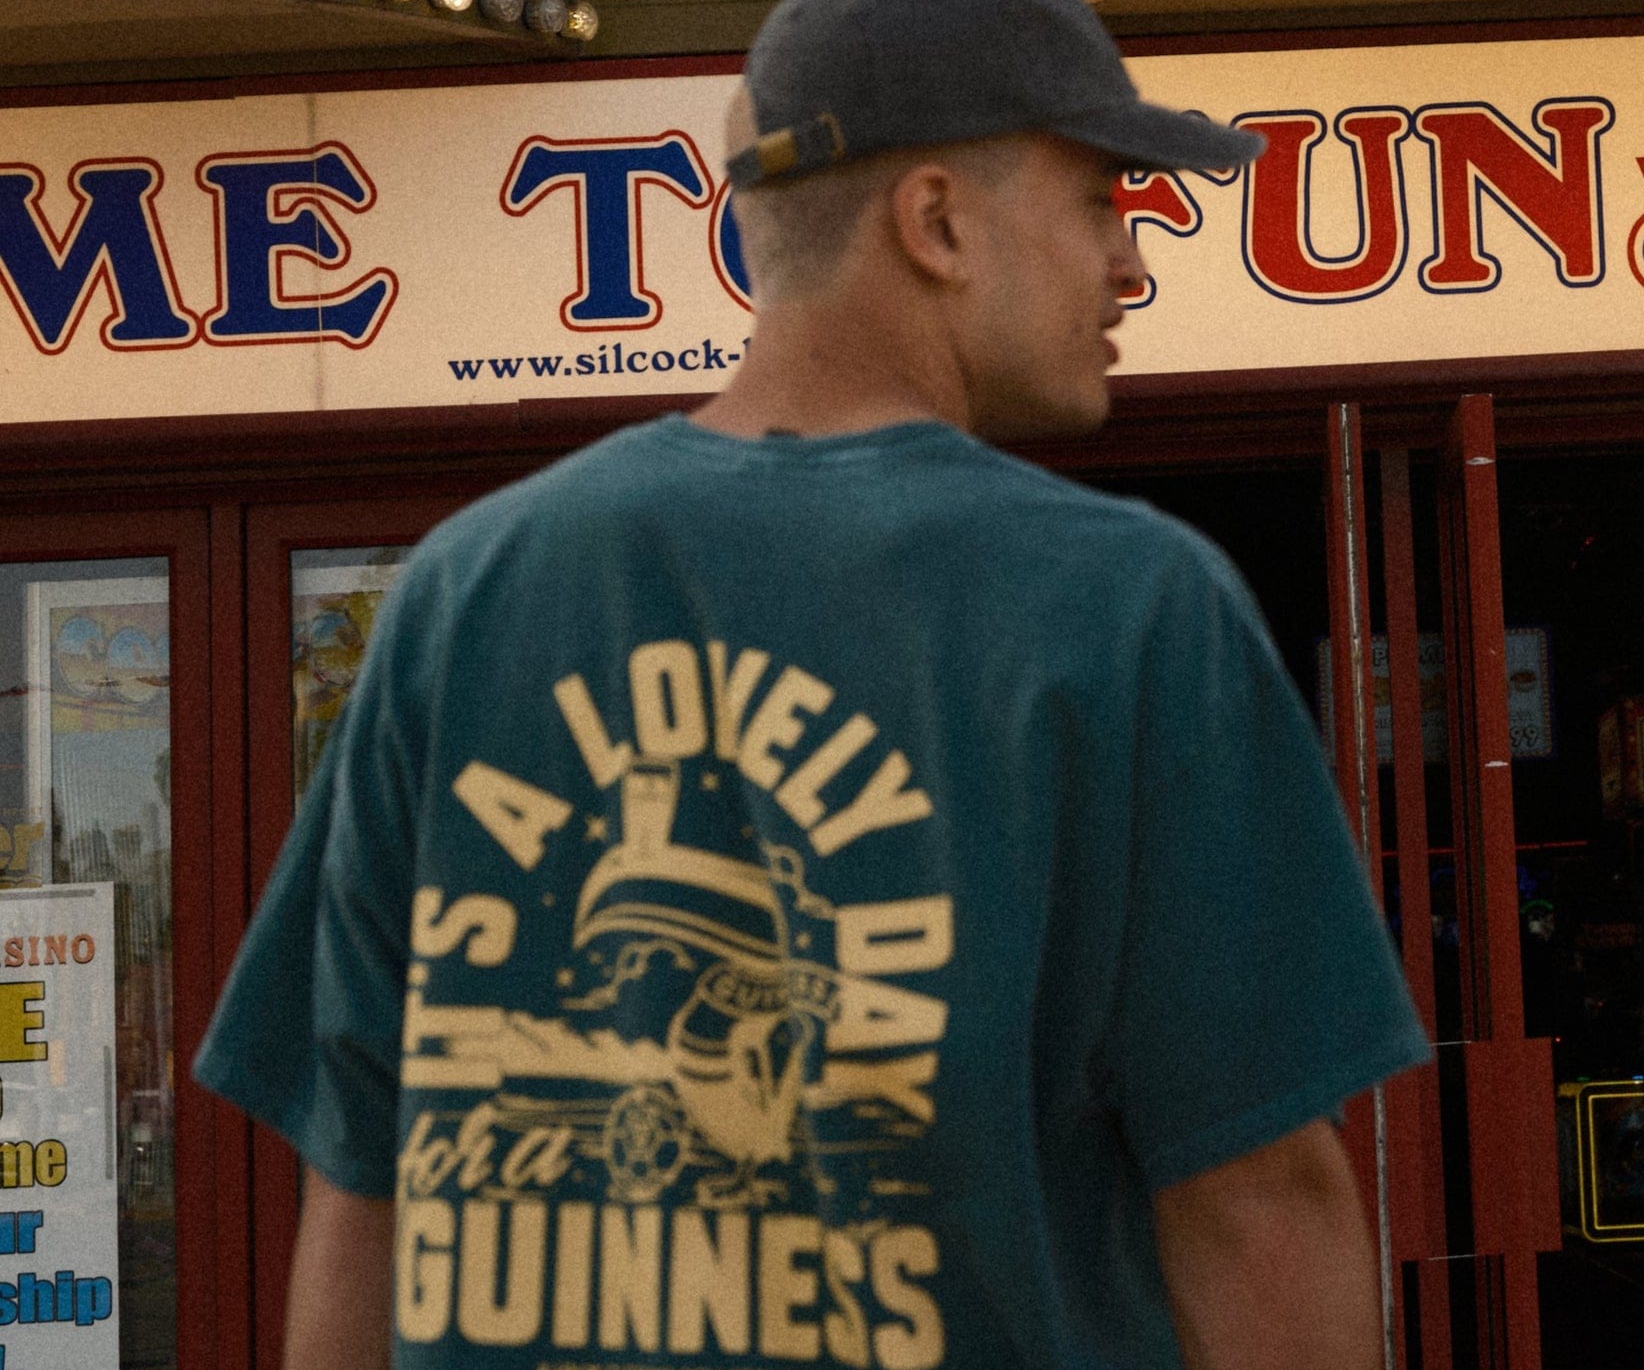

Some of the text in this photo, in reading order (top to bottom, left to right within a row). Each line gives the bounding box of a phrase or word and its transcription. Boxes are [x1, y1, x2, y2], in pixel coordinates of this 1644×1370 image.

[500, 129, 755, 331] T
[447, 337, 751, 381] www.silcock-
[451, 760, 574, 871] A
[552, 638, 934, 858] LOVELY
[808, 892, 955, 1124] DAY
[0, 933, 96, 968] SINO
